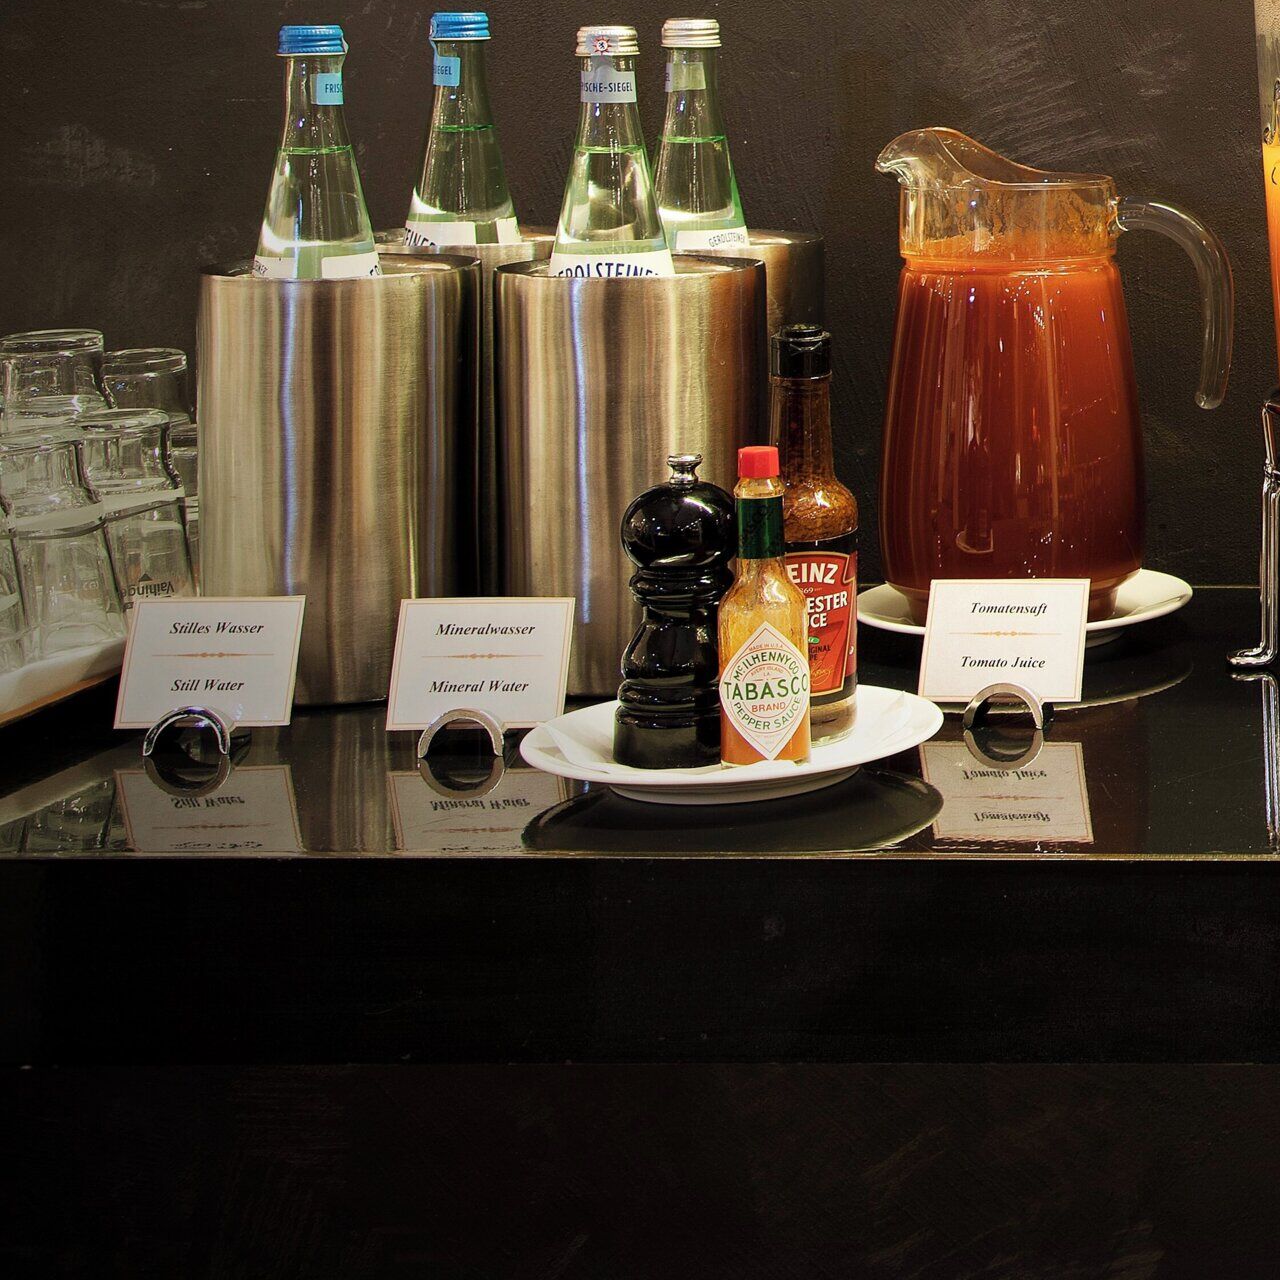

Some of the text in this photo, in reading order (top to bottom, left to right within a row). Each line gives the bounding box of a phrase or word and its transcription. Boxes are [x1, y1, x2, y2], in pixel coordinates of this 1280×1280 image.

[787, 563, 839, 585] EINZ
[119, 580, 175, 600] Vaihinge
[807, 591, 848, 613] ESTER
[970, 601, 1049, 616] Tomatensaft
[169, 620, 265, 635] Stilles Wasser
[435, 622, 536, 637] Mineralwasser
[961, 655, 1046, 670] Tomato Juice
[171, 677, 245, 692] Still Water
[429, 680, 530, 694] Mineral Water
[723, 673, 809, 701] TABASCO
[733, 696, 802, 731] PEPPER SAUCE
[751, 701, 787, 713] BRAND
